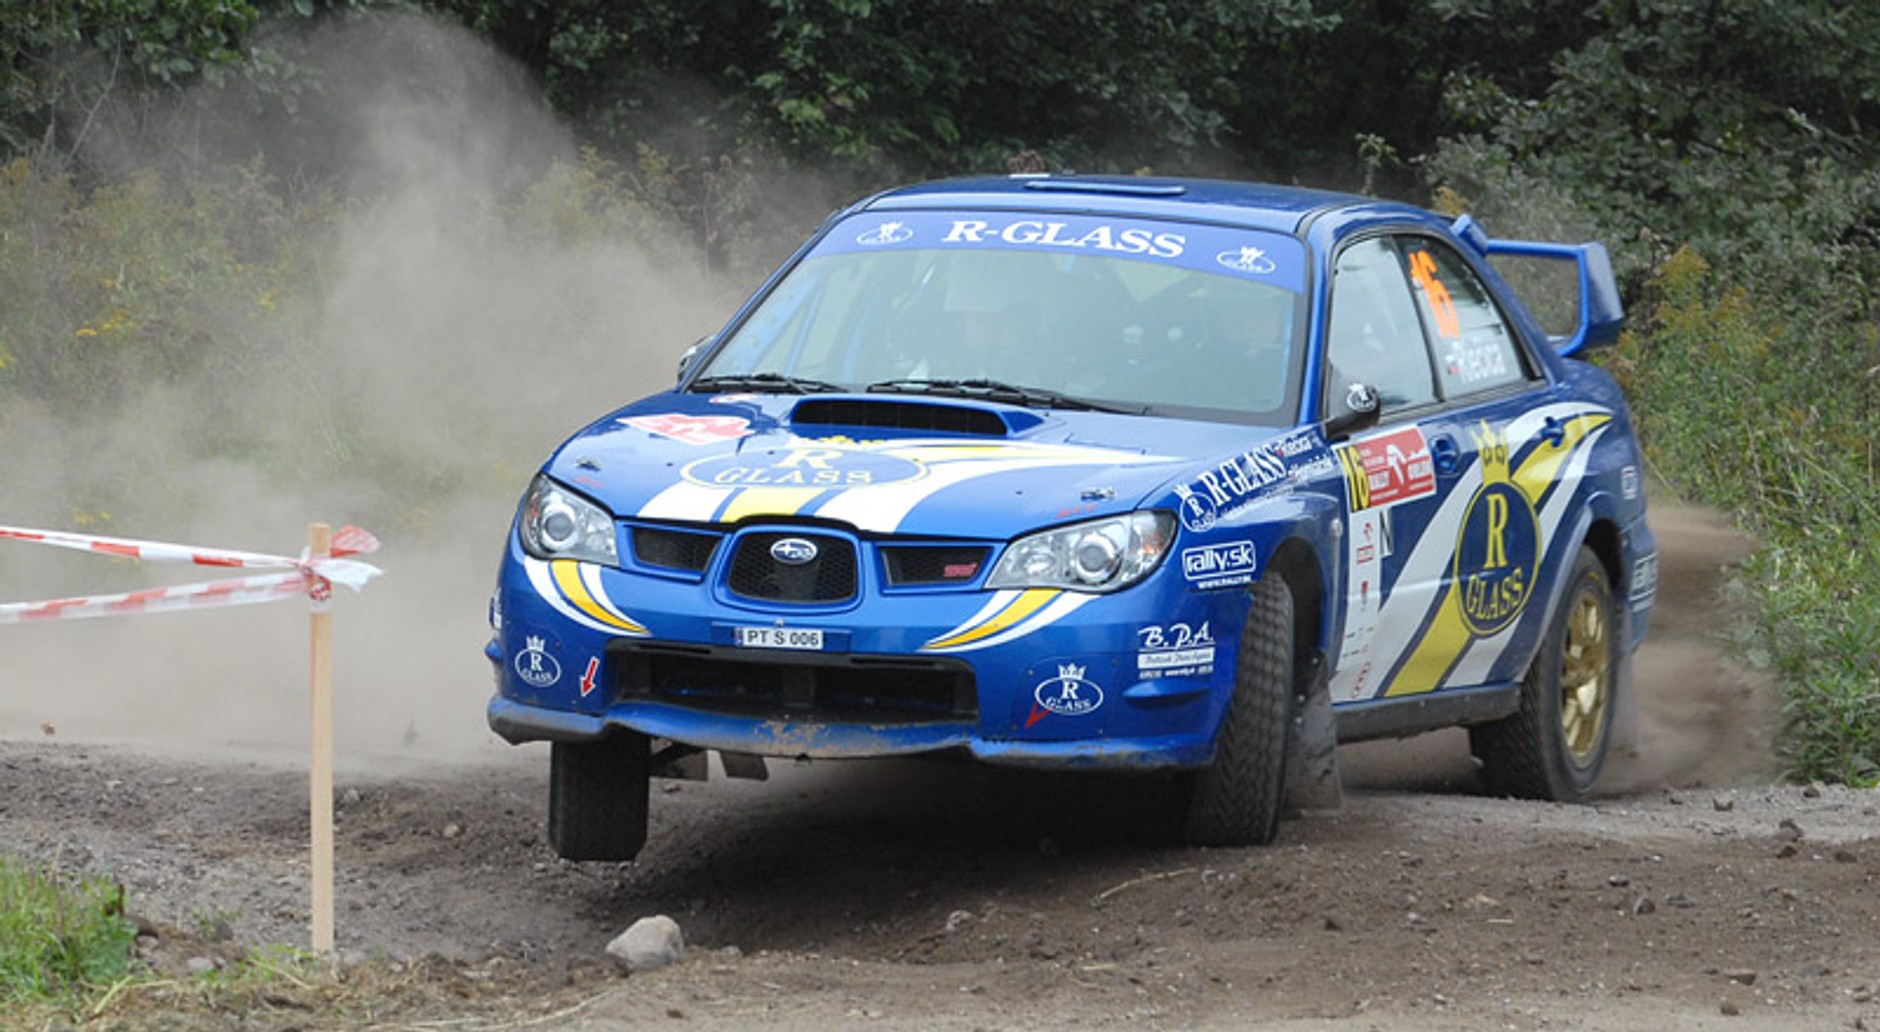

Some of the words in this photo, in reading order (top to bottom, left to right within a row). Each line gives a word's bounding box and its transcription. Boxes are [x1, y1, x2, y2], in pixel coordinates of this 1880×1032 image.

[941, 220, 1186, 258] R-GLASS
[772, 449, 844, 469] R
[713, 467, 873, 484] GLASS
[1196, 443, 1288, 507] R-GLASS
[1340, 445, 1370, 510] 16
[1187, 497, 1204, 516] R
[1483, 493, 1508, 568] R
[1187, 544, 1252, 572] rally.sk
[1466, 566, 1523, 620] GLASS
[747, 630, 769, 643] PT
[774, 630, 785, 645] S
[790, 632, 819, 647] 006
[530, 652, 543, 671] R
[1061, 680, 1079, 699] R
[1046, 696, 1091, 712] GLASS
